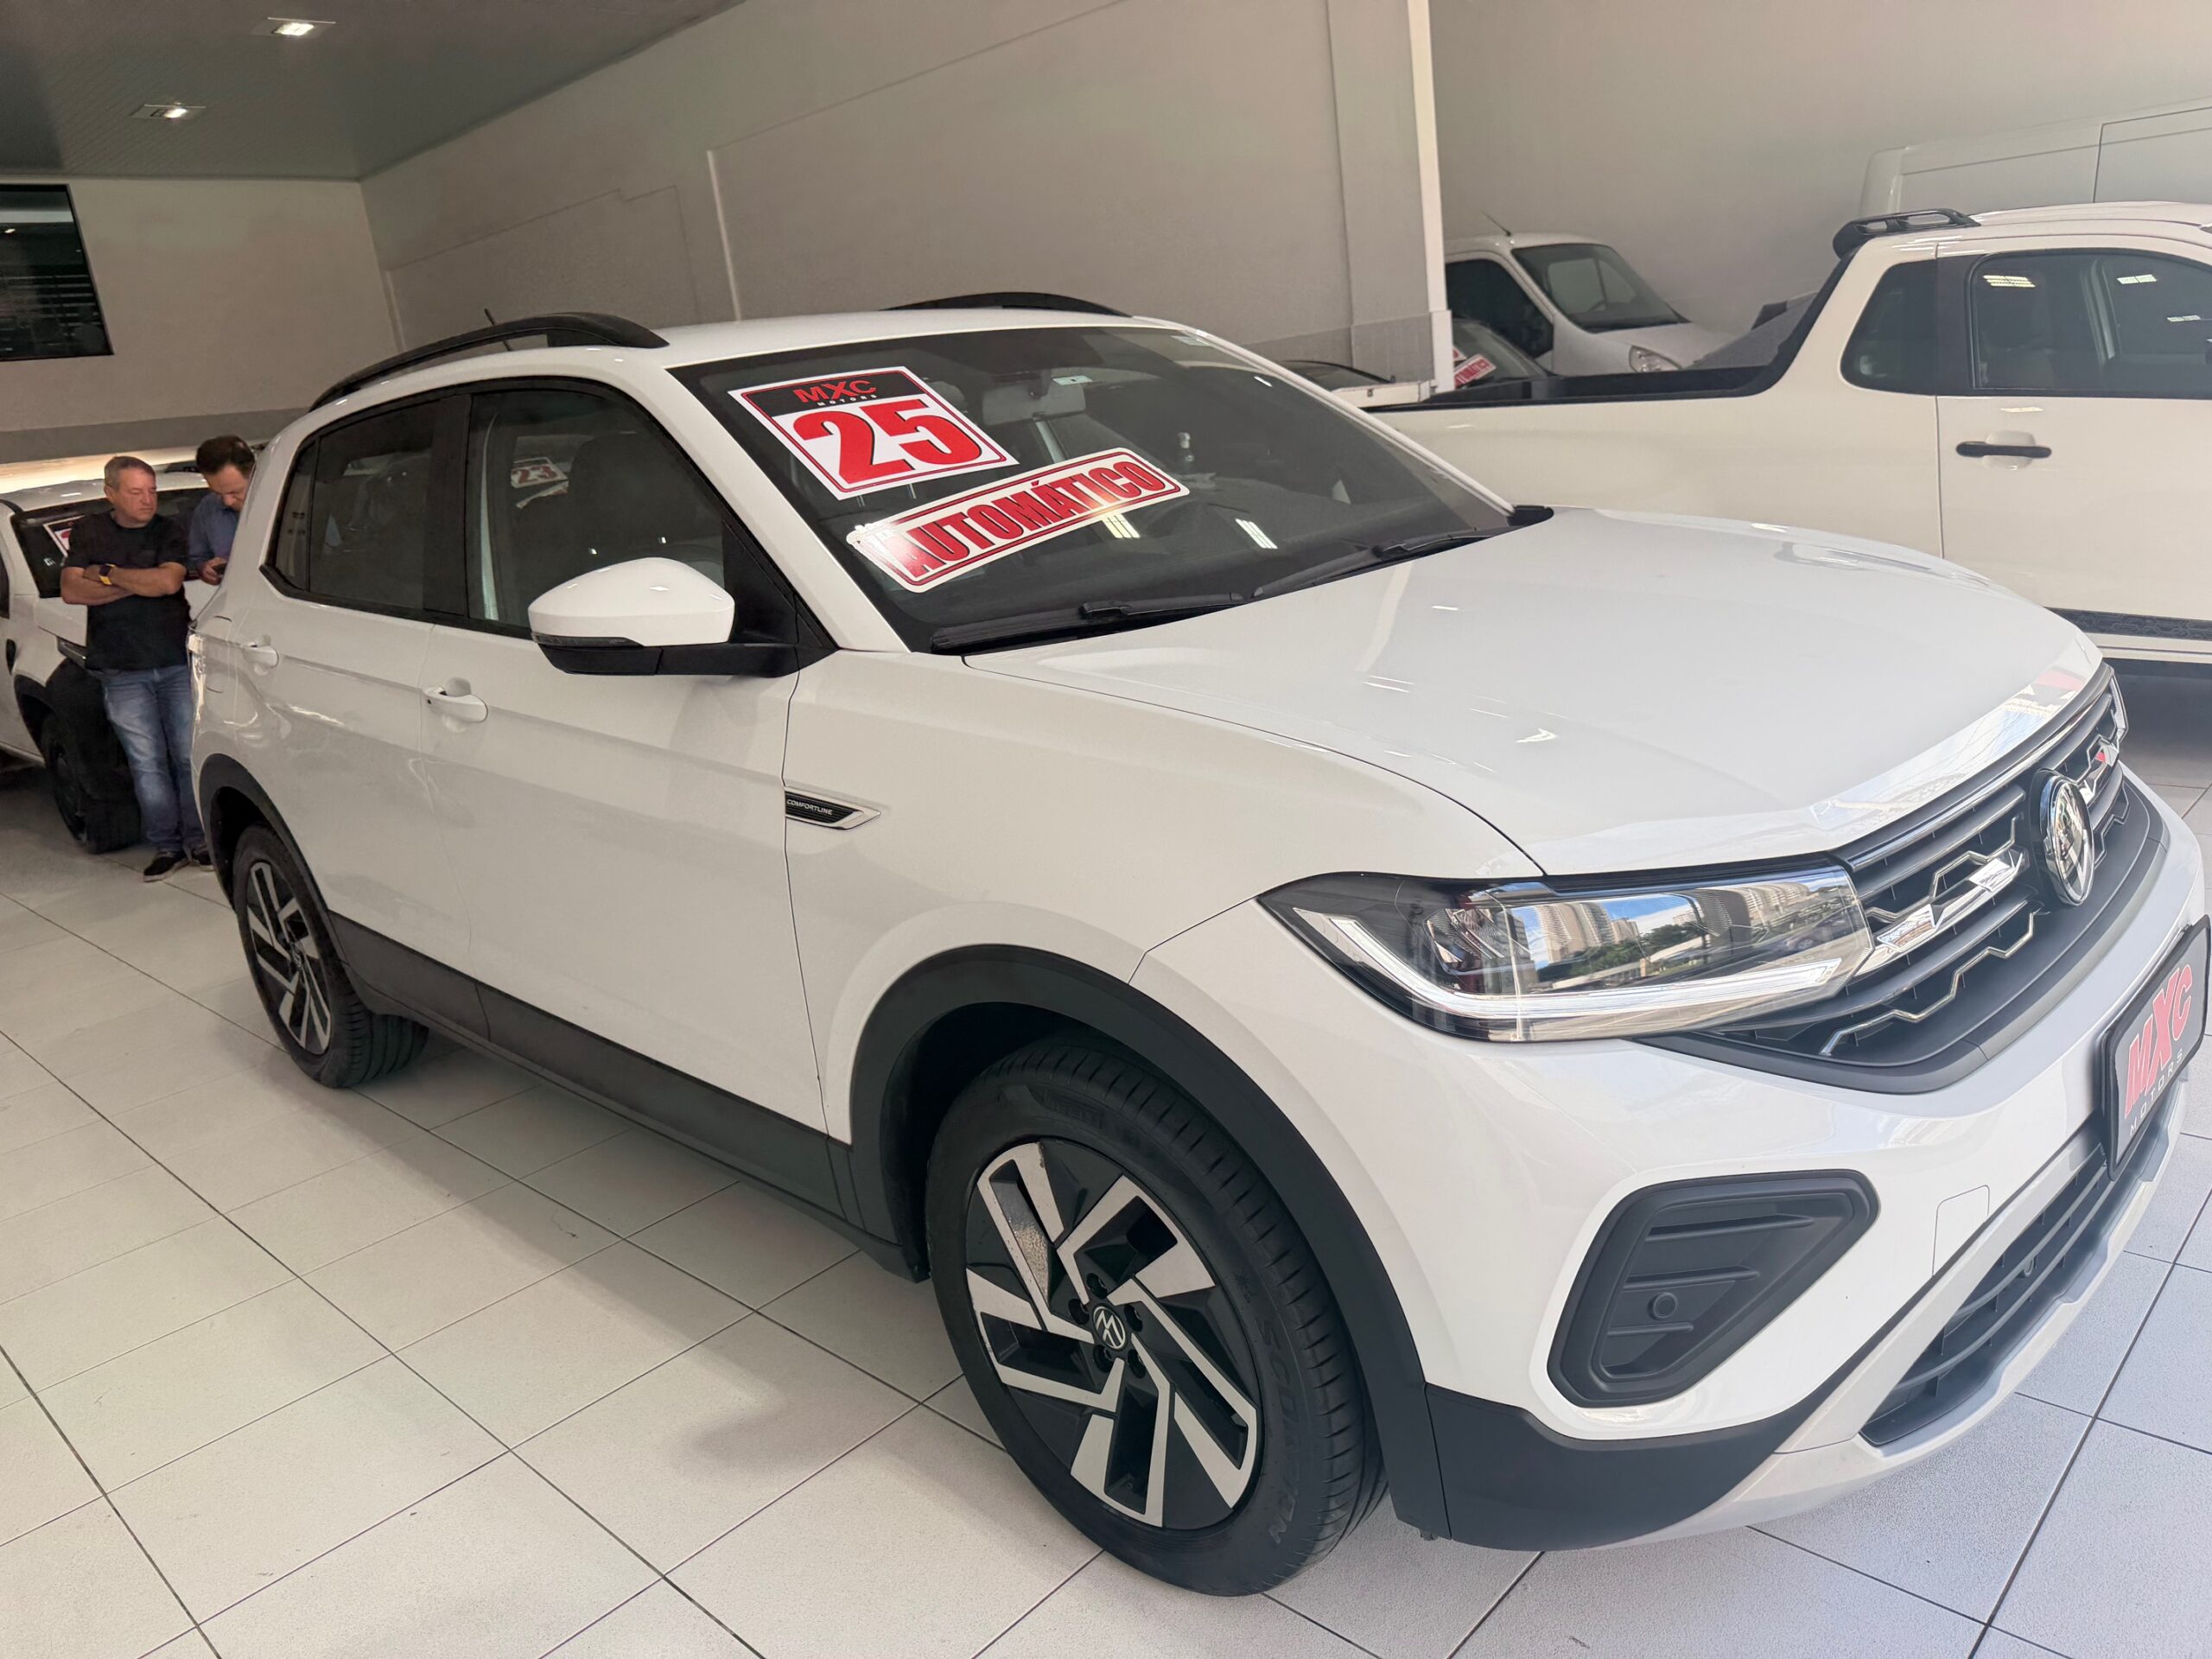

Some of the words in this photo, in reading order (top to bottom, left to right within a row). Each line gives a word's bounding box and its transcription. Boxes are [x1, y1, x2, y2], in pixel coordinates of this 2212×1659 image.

[793, 380, 876, 403] MXC
[817, 394, 877, 406] MOTORS
[792, 398, 982, 485] 25
[883, 461, 1167, 578] AUTOMÁTICO
[786, 798, 833, 816] COMFORTLINE
[2124, 963, 2193, 1120] MXC
[2129, 1048, 2183, 1136] MOTORS
